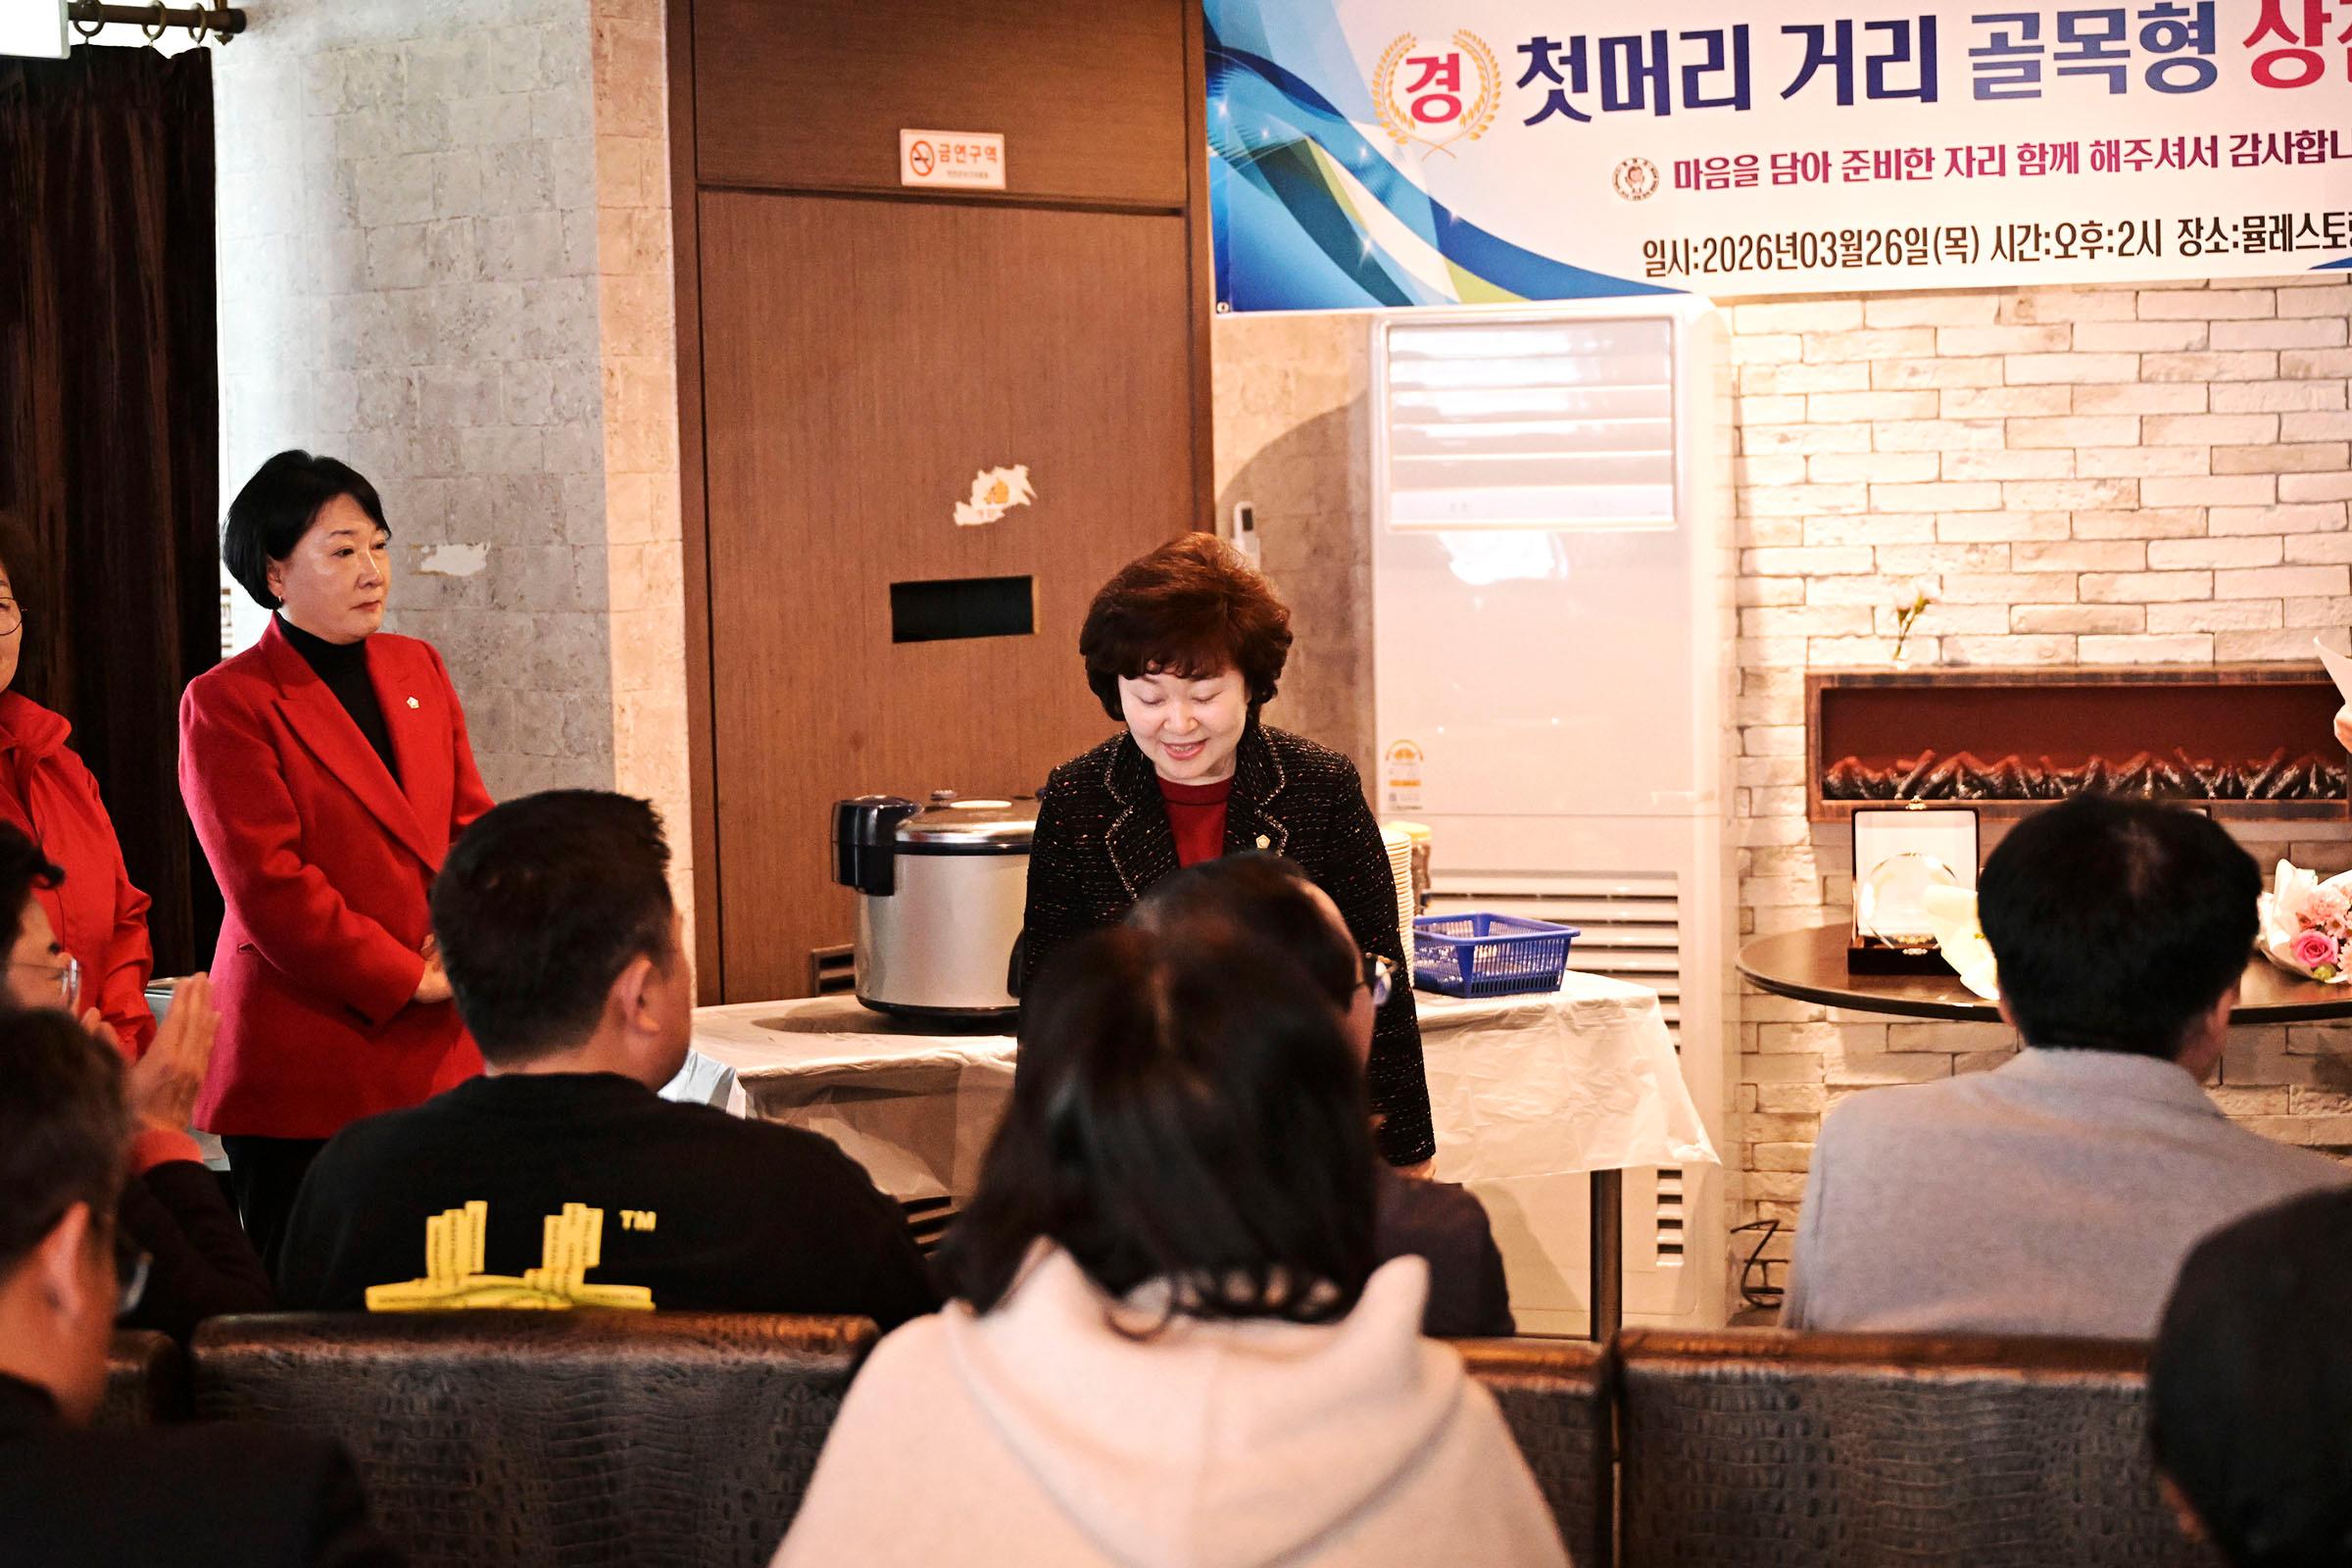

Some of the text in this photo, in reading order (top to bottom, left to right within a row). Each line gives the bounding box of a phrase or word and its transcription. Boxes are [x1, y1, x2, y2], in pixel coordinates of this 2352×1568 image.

[1405, 0, 2352, 126] 경 첫머리 거리 골목형 상
[939, 142, 997, 165] 금연구역
[1674, 154, 1759, 191] 마음을
[1770, 151, 1832, 186] 담아
[1841, 147, 1936, 183] 준비한
[1943, 144, 2006, 179] 자리
[2017, 141, 2079, 176] 함께
[2089, 135, 2219, 172] 해주셔서
[1642, 212, 2352, 277] 일시:2026년03월26일(목) 시간:오후:2시 장소:뮬레스토
[619, 1209, 658, 1232] TM
